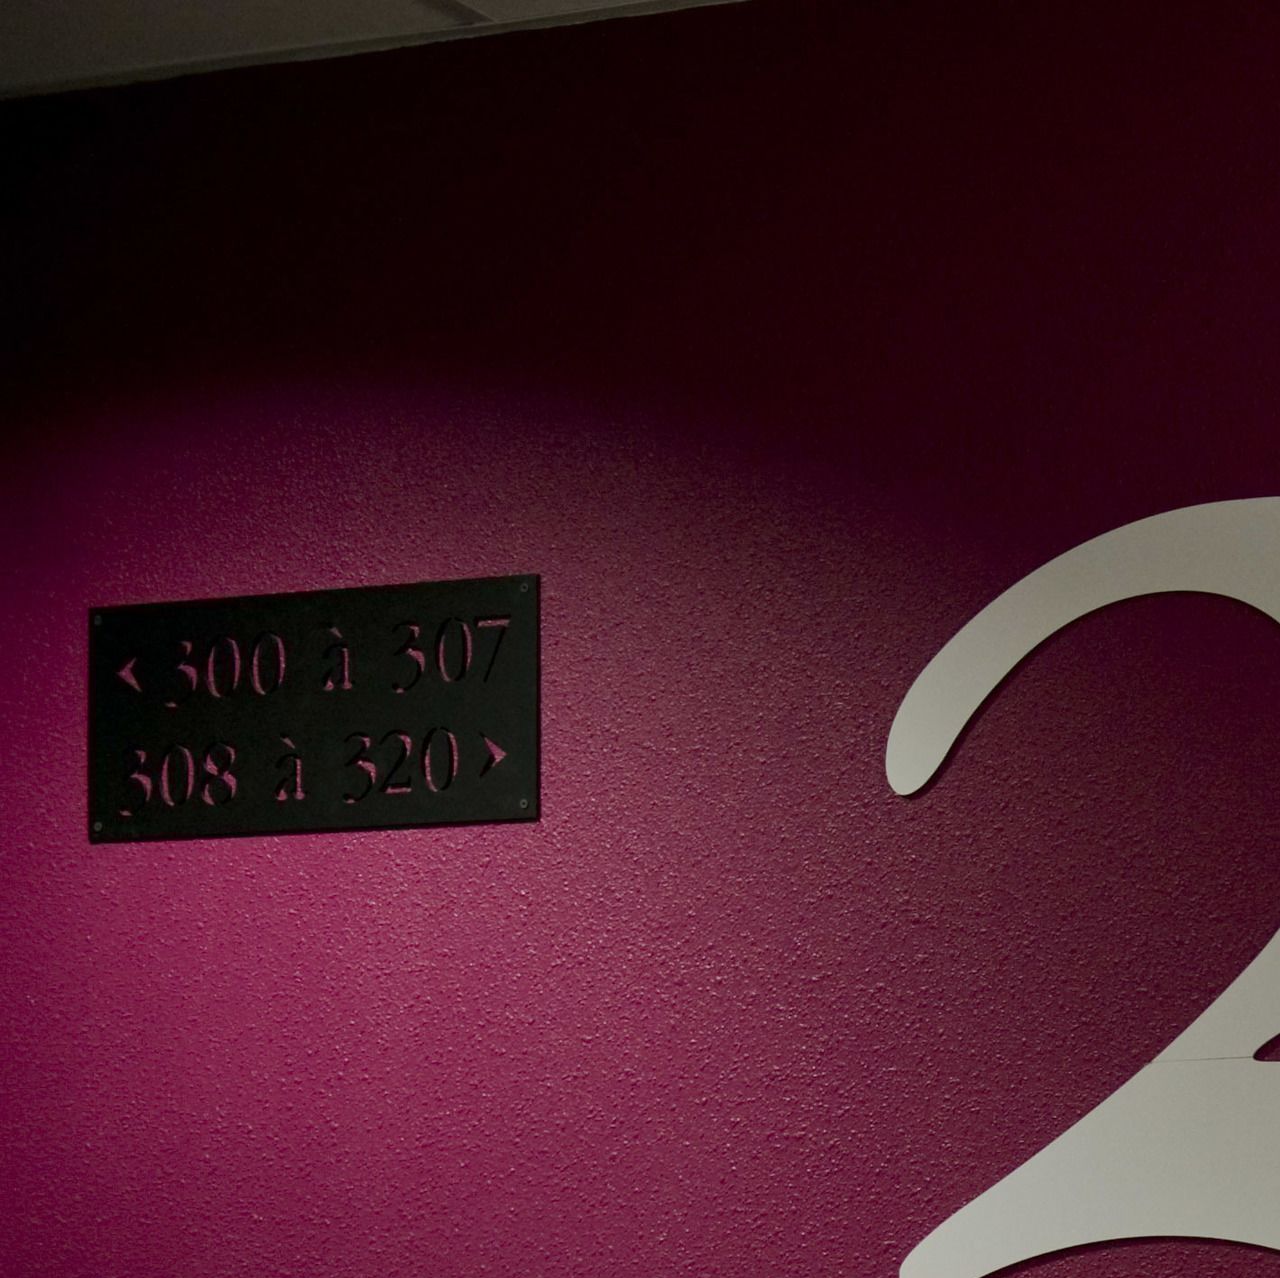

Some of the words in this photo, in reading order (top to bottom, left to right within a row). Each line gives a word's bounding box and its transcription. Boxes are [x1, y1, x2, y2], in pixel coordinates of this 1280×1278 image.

[164, 630, 287, 709] 300
[321, 626, 354, 692] à
[391, 613, 513, 695] 307
[118, 740, 239, 818] 308
[273, 734, 307, 802] à
[341, 725, 460, 805] 320
